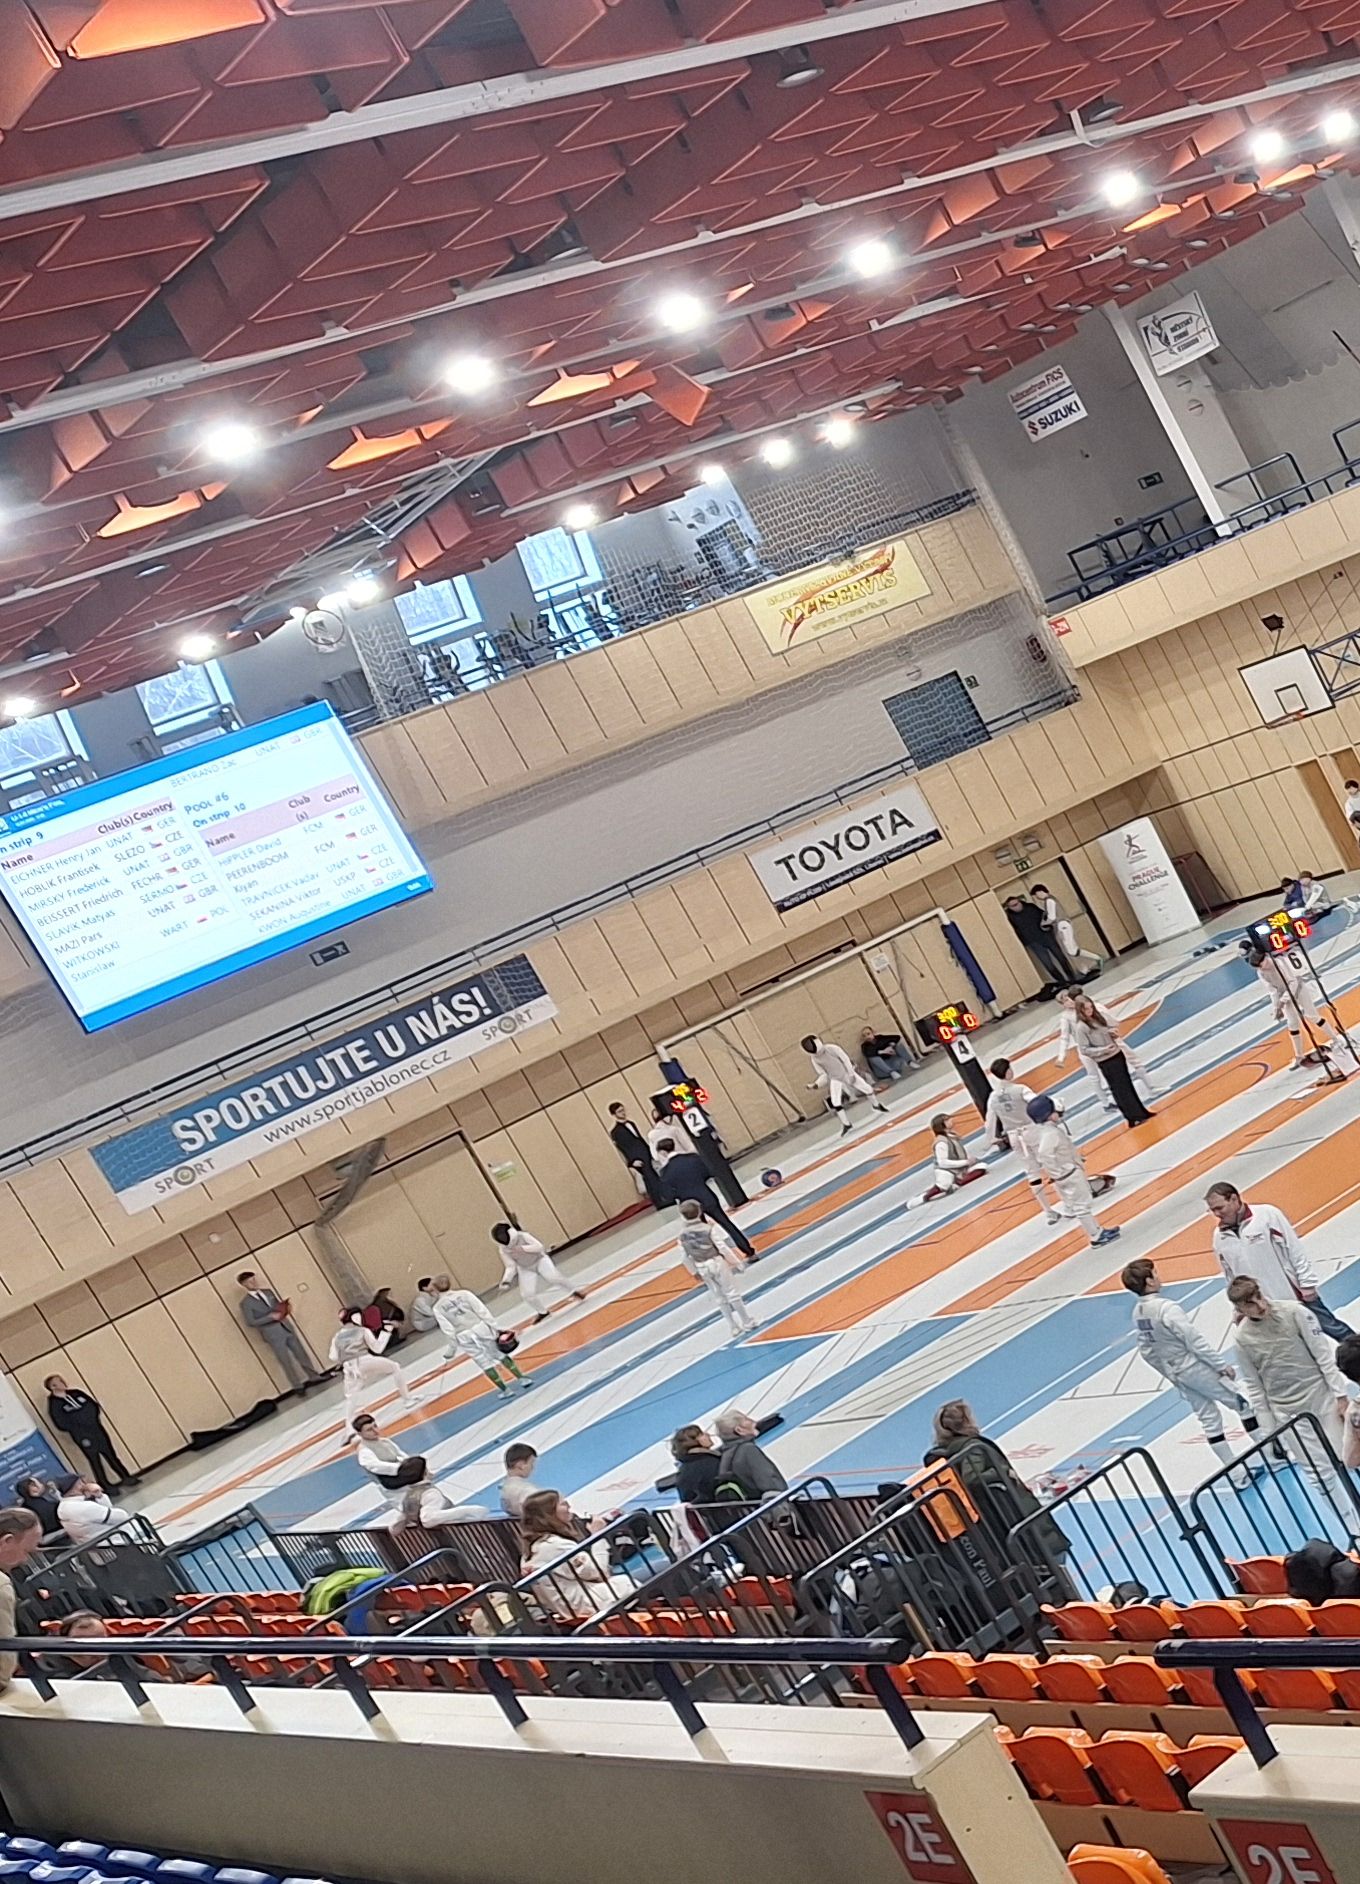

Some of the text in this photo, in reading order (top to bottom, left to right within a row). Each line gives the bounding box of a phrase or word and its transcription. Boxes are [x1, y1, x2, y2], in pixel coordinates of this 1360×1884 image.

[1038, 400, 1080, 429] SUZUKI
[780, 568, 897, 624] VYTSERVIS
[205, 784, 360, 848] Name Club Country
[348, 804, 367, 817] GER
[0, 801, 173, 870] Name Club(s) Country
[9, 837, 33, 851] strip
[36, 832, 43, 840] 9
[54, 851, 84, 869] Henry
[106, 832, 134, 848] UNAT
[157, 816, 176, 829] GER
[360, 824, 378, 837] GER
[774, 808, 915, 881] TOYOTA
[19, 831, 184, 899] HOBLIK Frantisek SLEZO CZE
[371, 843, 388, 856] CZE
[378, 857, 395, 869] CZE
[67, 876, 111, 897] Frederick
[123, 860, 151, 876] UNAT
[173, 844, 194, 857] GBR
[37, 858, 201, 927] BEISSERT Friedrich FECHR GER
[147, 901, 176, 917] UNAT
[198, 885, 219, 898] GBR
[341, 884, 367, 900] UNAT
[45, 922, 79, 941] SLAVIK
[82, 909, 115, 927] Matyas
[1270, 921, 1307, 949] 0 0
[63, 941, 120, 969] WITKOWSKI
[1288, 952, 1302, 970] 6
[482, 1009, 533, 1041] SPORT
[939, 1013, 975, 1040] 0 0
[958, 1040, 969, 1055] 4
[172, 986, 492, 1152] SPORTUJTE U NÁS!
[264, 1049, 452, 1143] www.sportjablonec.cz
[694, 1089, 707, 1101] 2
[688, 1113, 701, 1127] 2
[154, 1157, 215, 1194] SPORT
[887, 1811, 956, 1864] 2E
[1247, 1844, 1320, 1884] 2E
